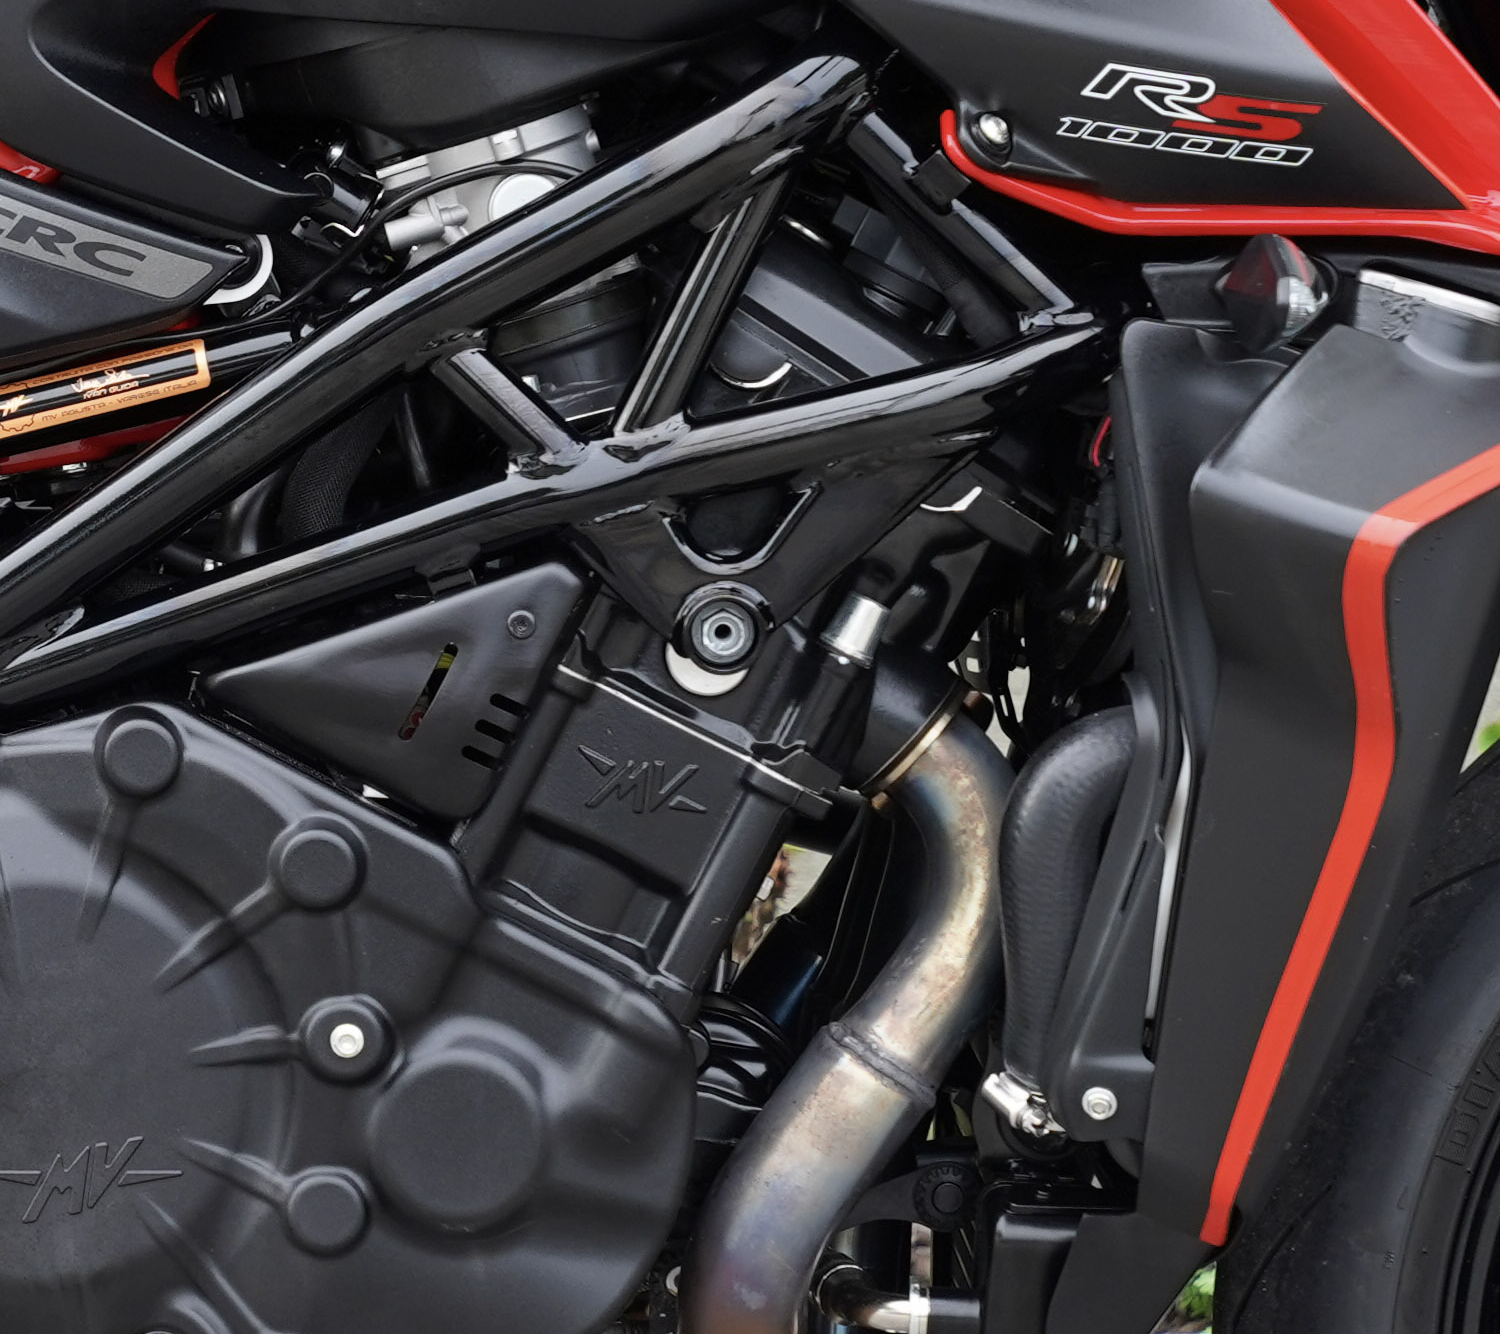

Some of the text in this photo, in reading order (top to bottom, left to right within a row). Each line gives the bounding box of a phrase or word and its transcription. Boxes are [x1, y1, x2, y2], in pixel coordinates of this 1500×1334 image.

[1080, 61, 1326, 139] RS
[1057, 114, 1314, 166] 1000
[21, 1135, 145, 1225] MV
